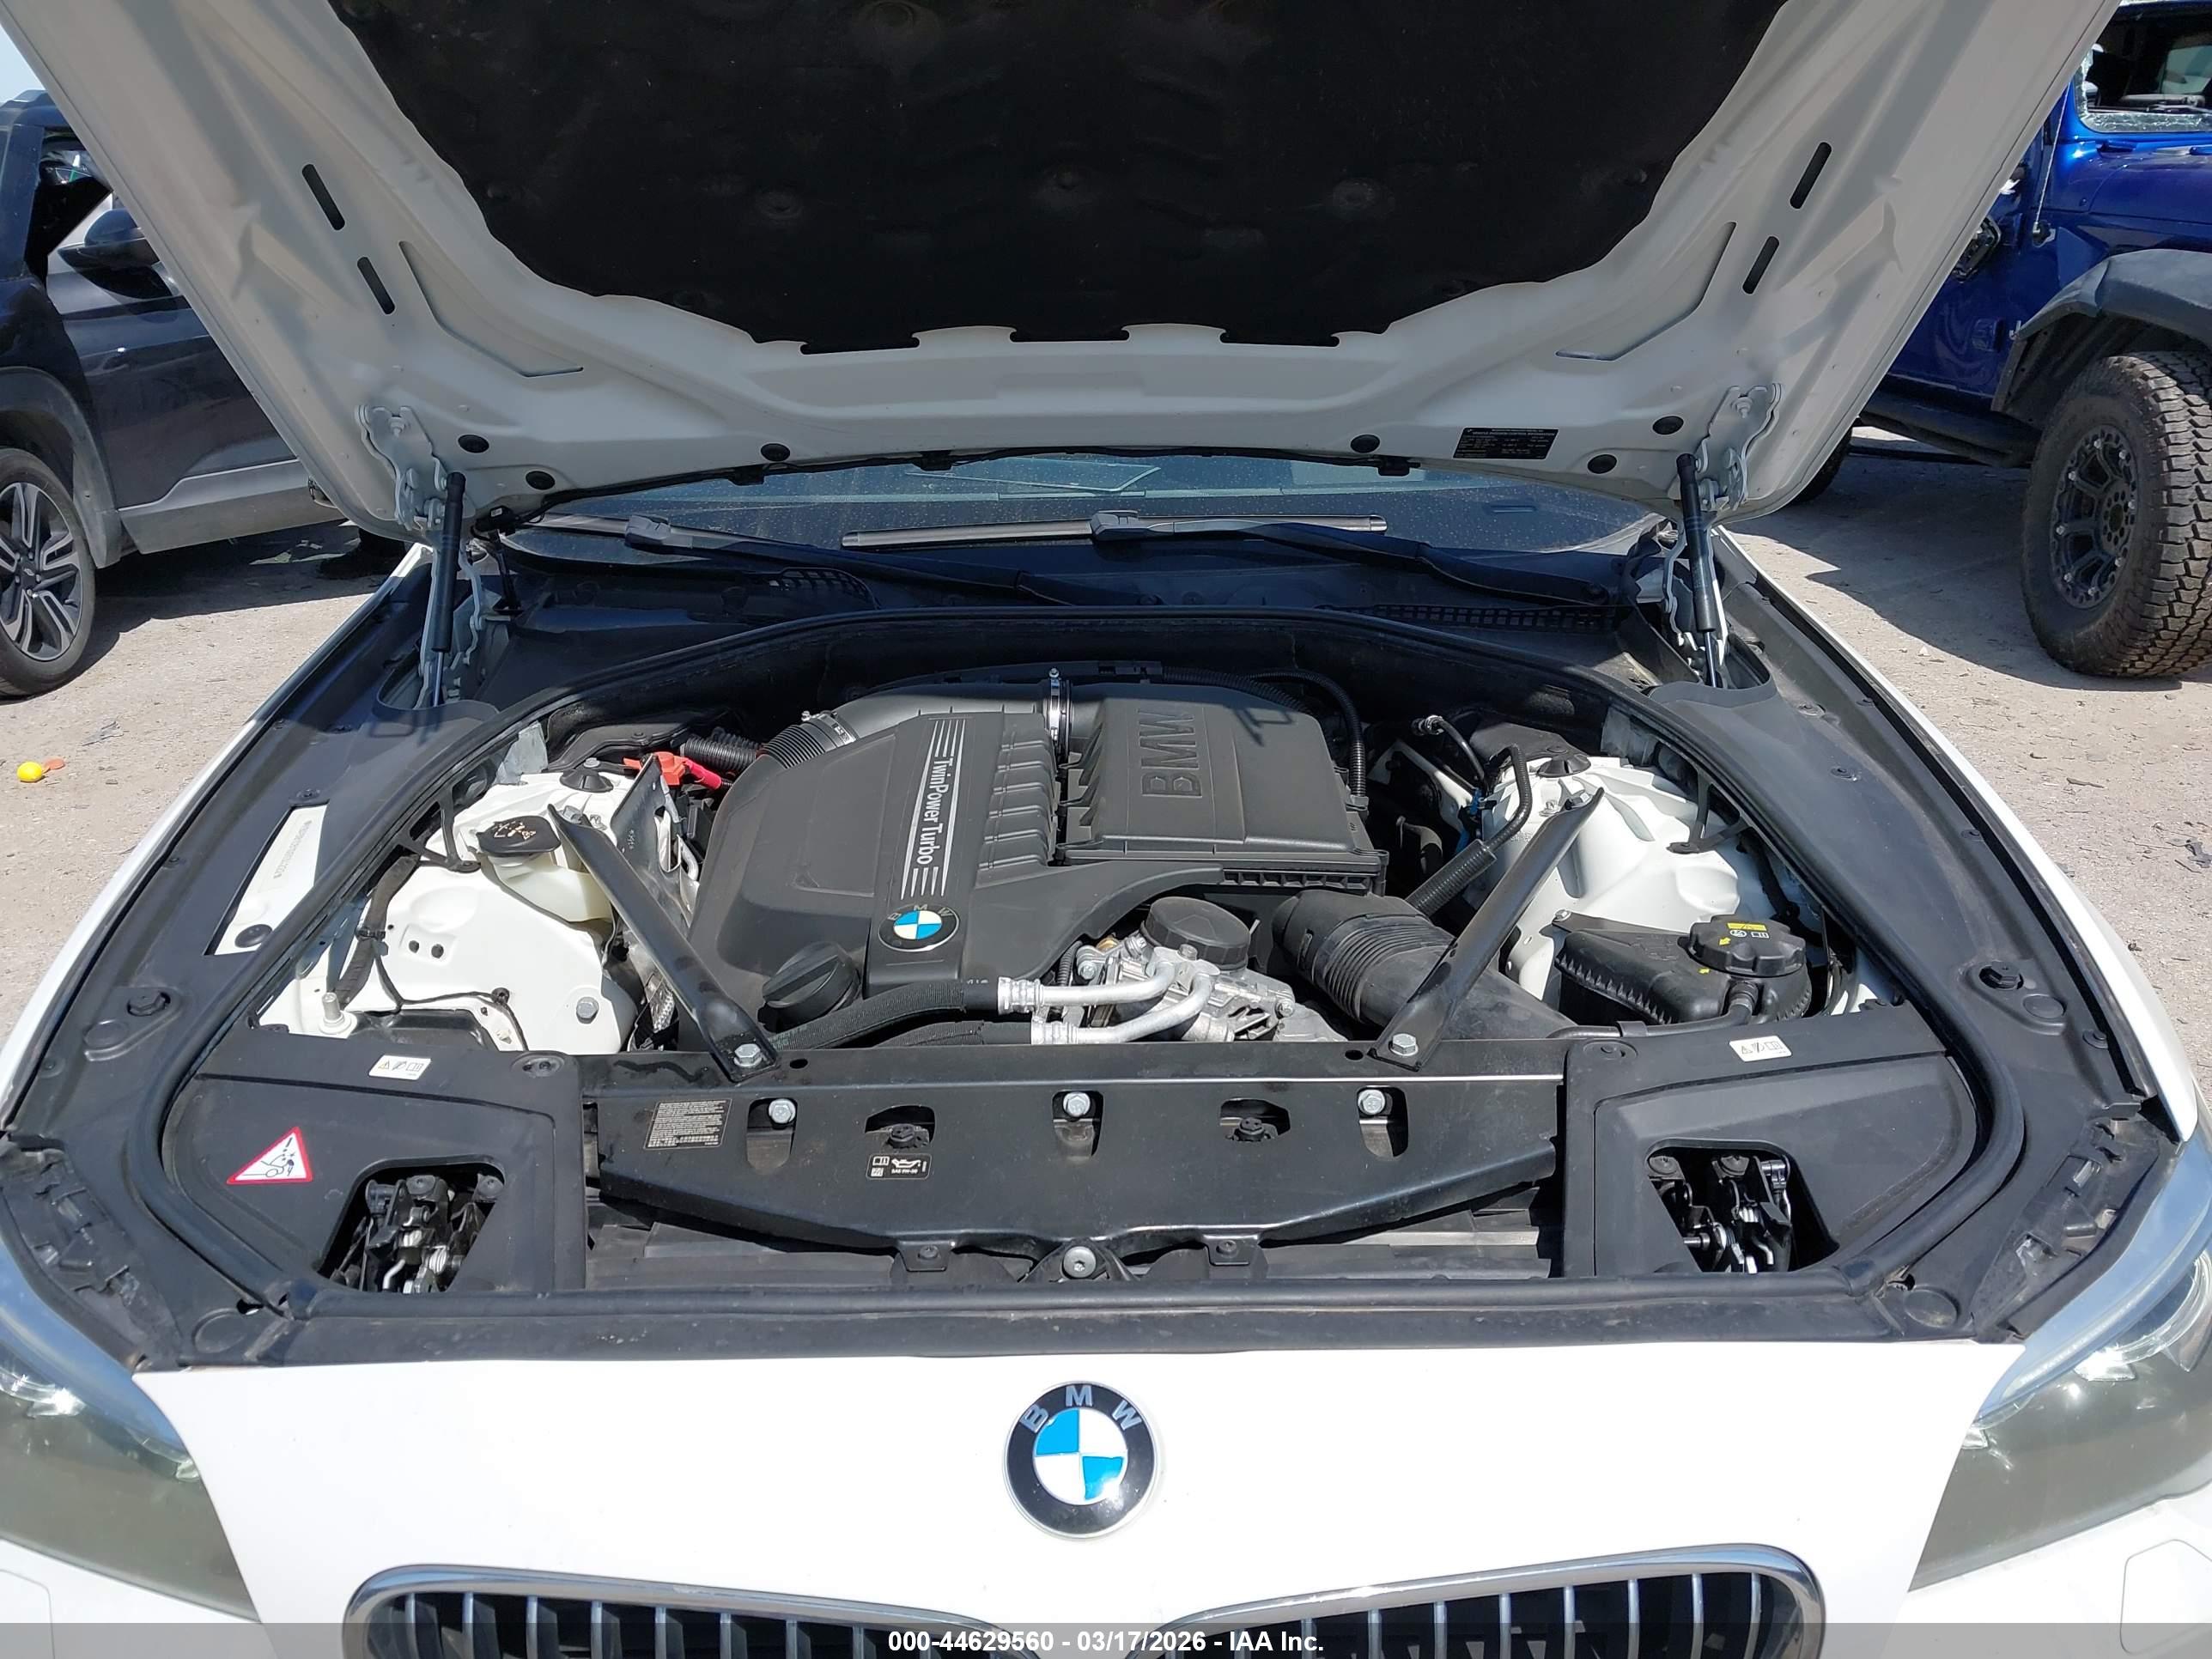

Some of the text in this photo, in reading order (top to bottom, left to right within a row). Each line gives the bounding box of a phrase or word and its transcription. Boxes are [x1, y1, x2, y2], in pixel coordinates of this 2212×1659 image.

[1137, 708, 1203, 799] BMW
[887, 903, 953, 921] BMW
[1019, 1384, 1144, 1434] BMW
